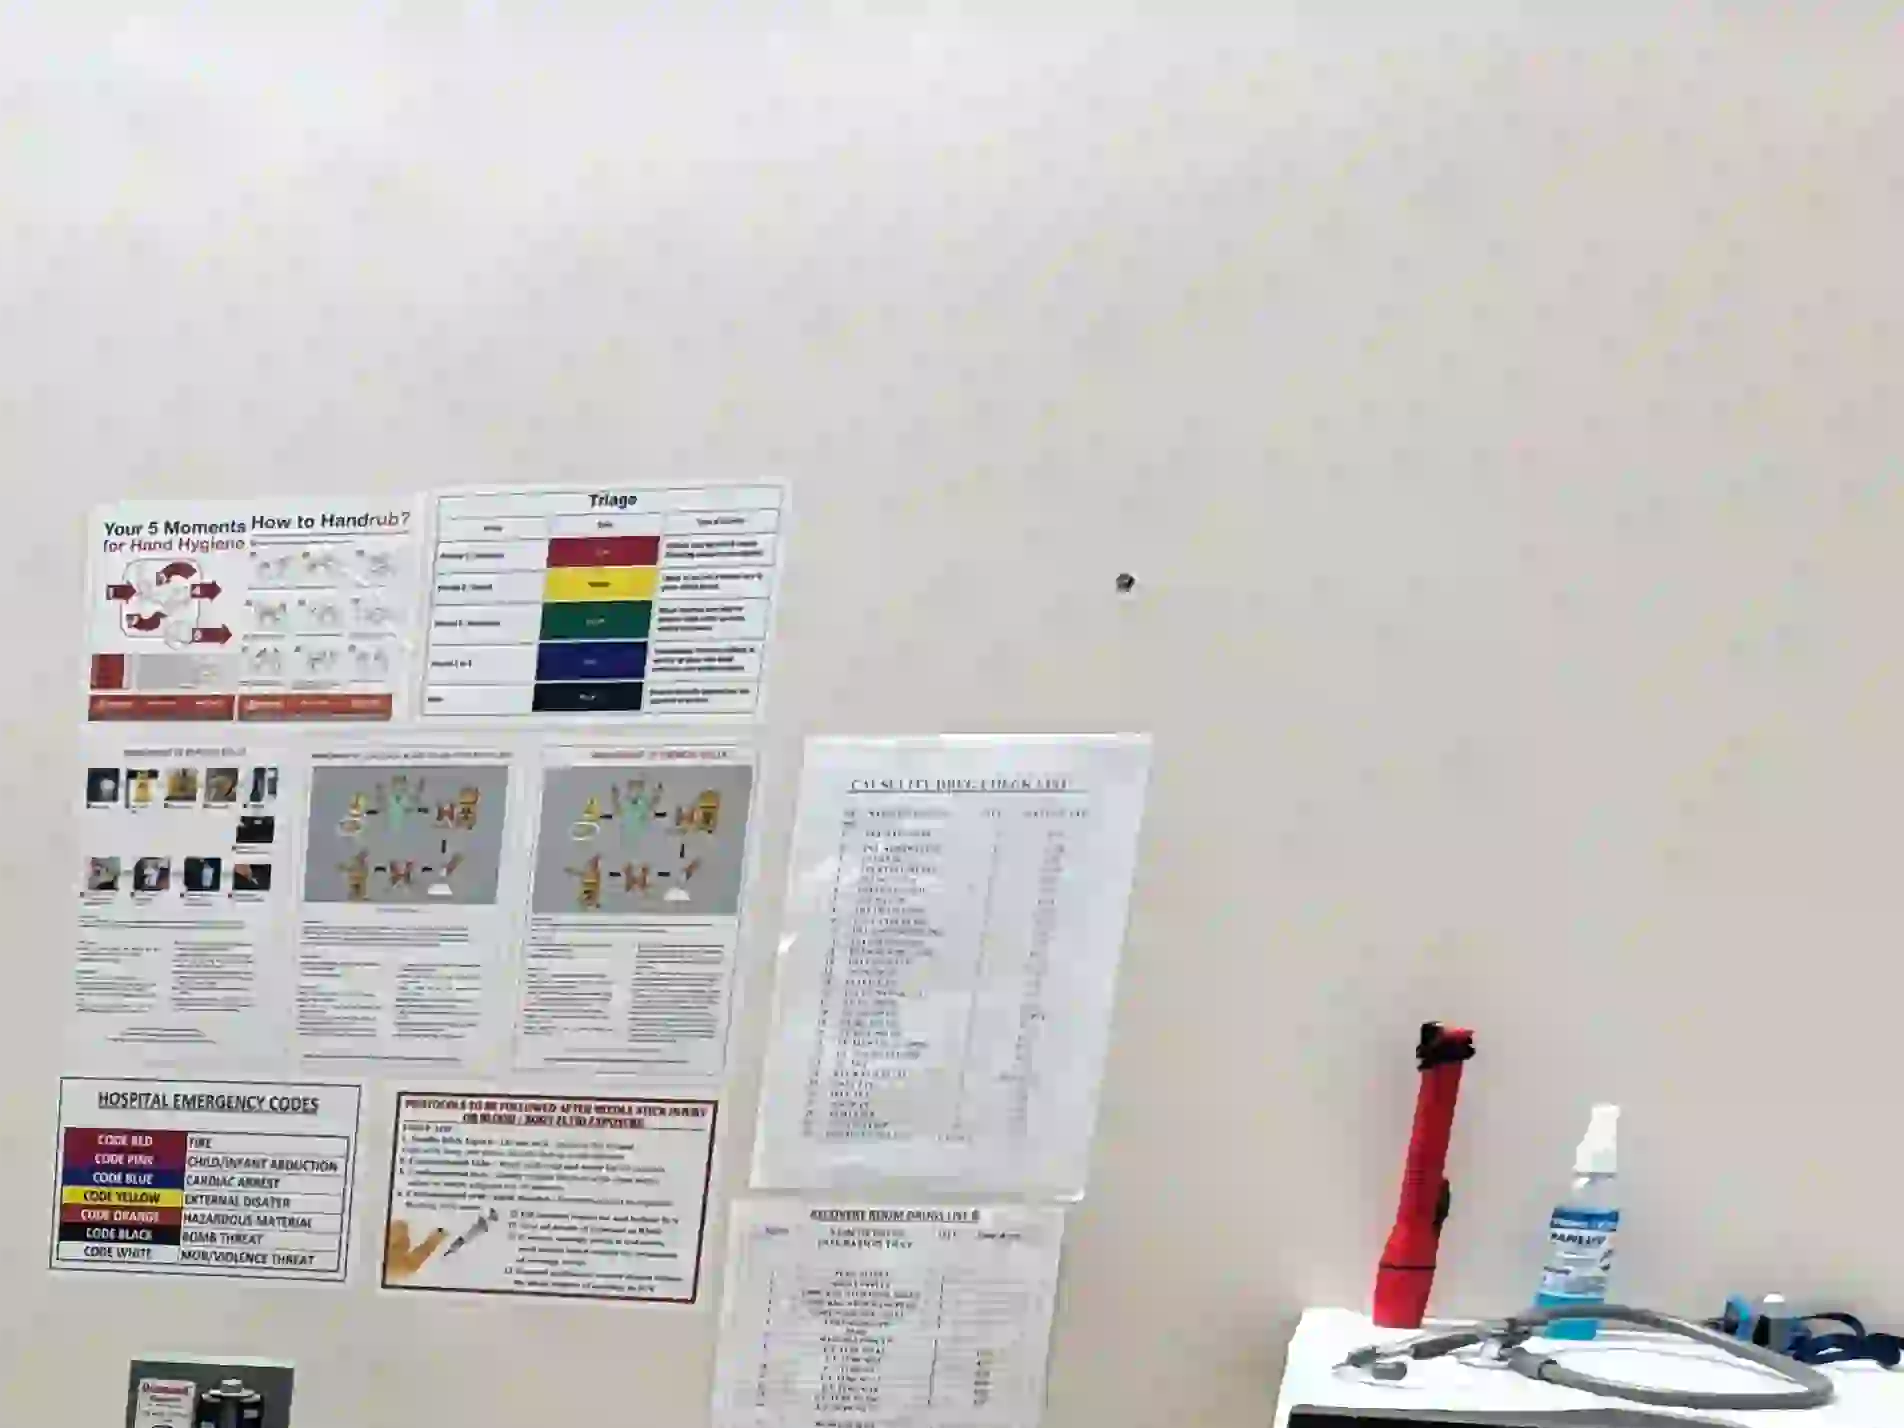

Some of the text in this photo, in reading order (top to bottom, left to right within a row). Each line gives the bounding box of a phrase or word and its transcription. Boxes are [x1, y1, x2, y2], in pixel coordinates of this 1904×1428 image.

[589, 493, 638, 509] Triage
[252, 510, 411, 529] How to Handrub?
[104, 519, 246, 536] Your 5 Moments
[103, 539, 127, 553] for
[130, 539, 173, 552] Hand
[98, 1091, 320, 1115] HOSPITAL EMERGENCY CODES
[97, 1134, 128, 1146] CODE
[94, 1153, 124, 1165] CODE
[270, 1160, 338, 1173] ABDUCTION
[92, 1171, 153, 1185] CODE BLUE
[83, 1191, 160, 1204] CODE YELLOW
[81, 1209, 110, 1221] CODE
[86, 1228, 153, 1240] CODE BLACK
[220, 1233, 264, 1245] THREAT
[84, 1246, 112, 1257] CODE
[272, 1254, 315, 1265] THREAT
